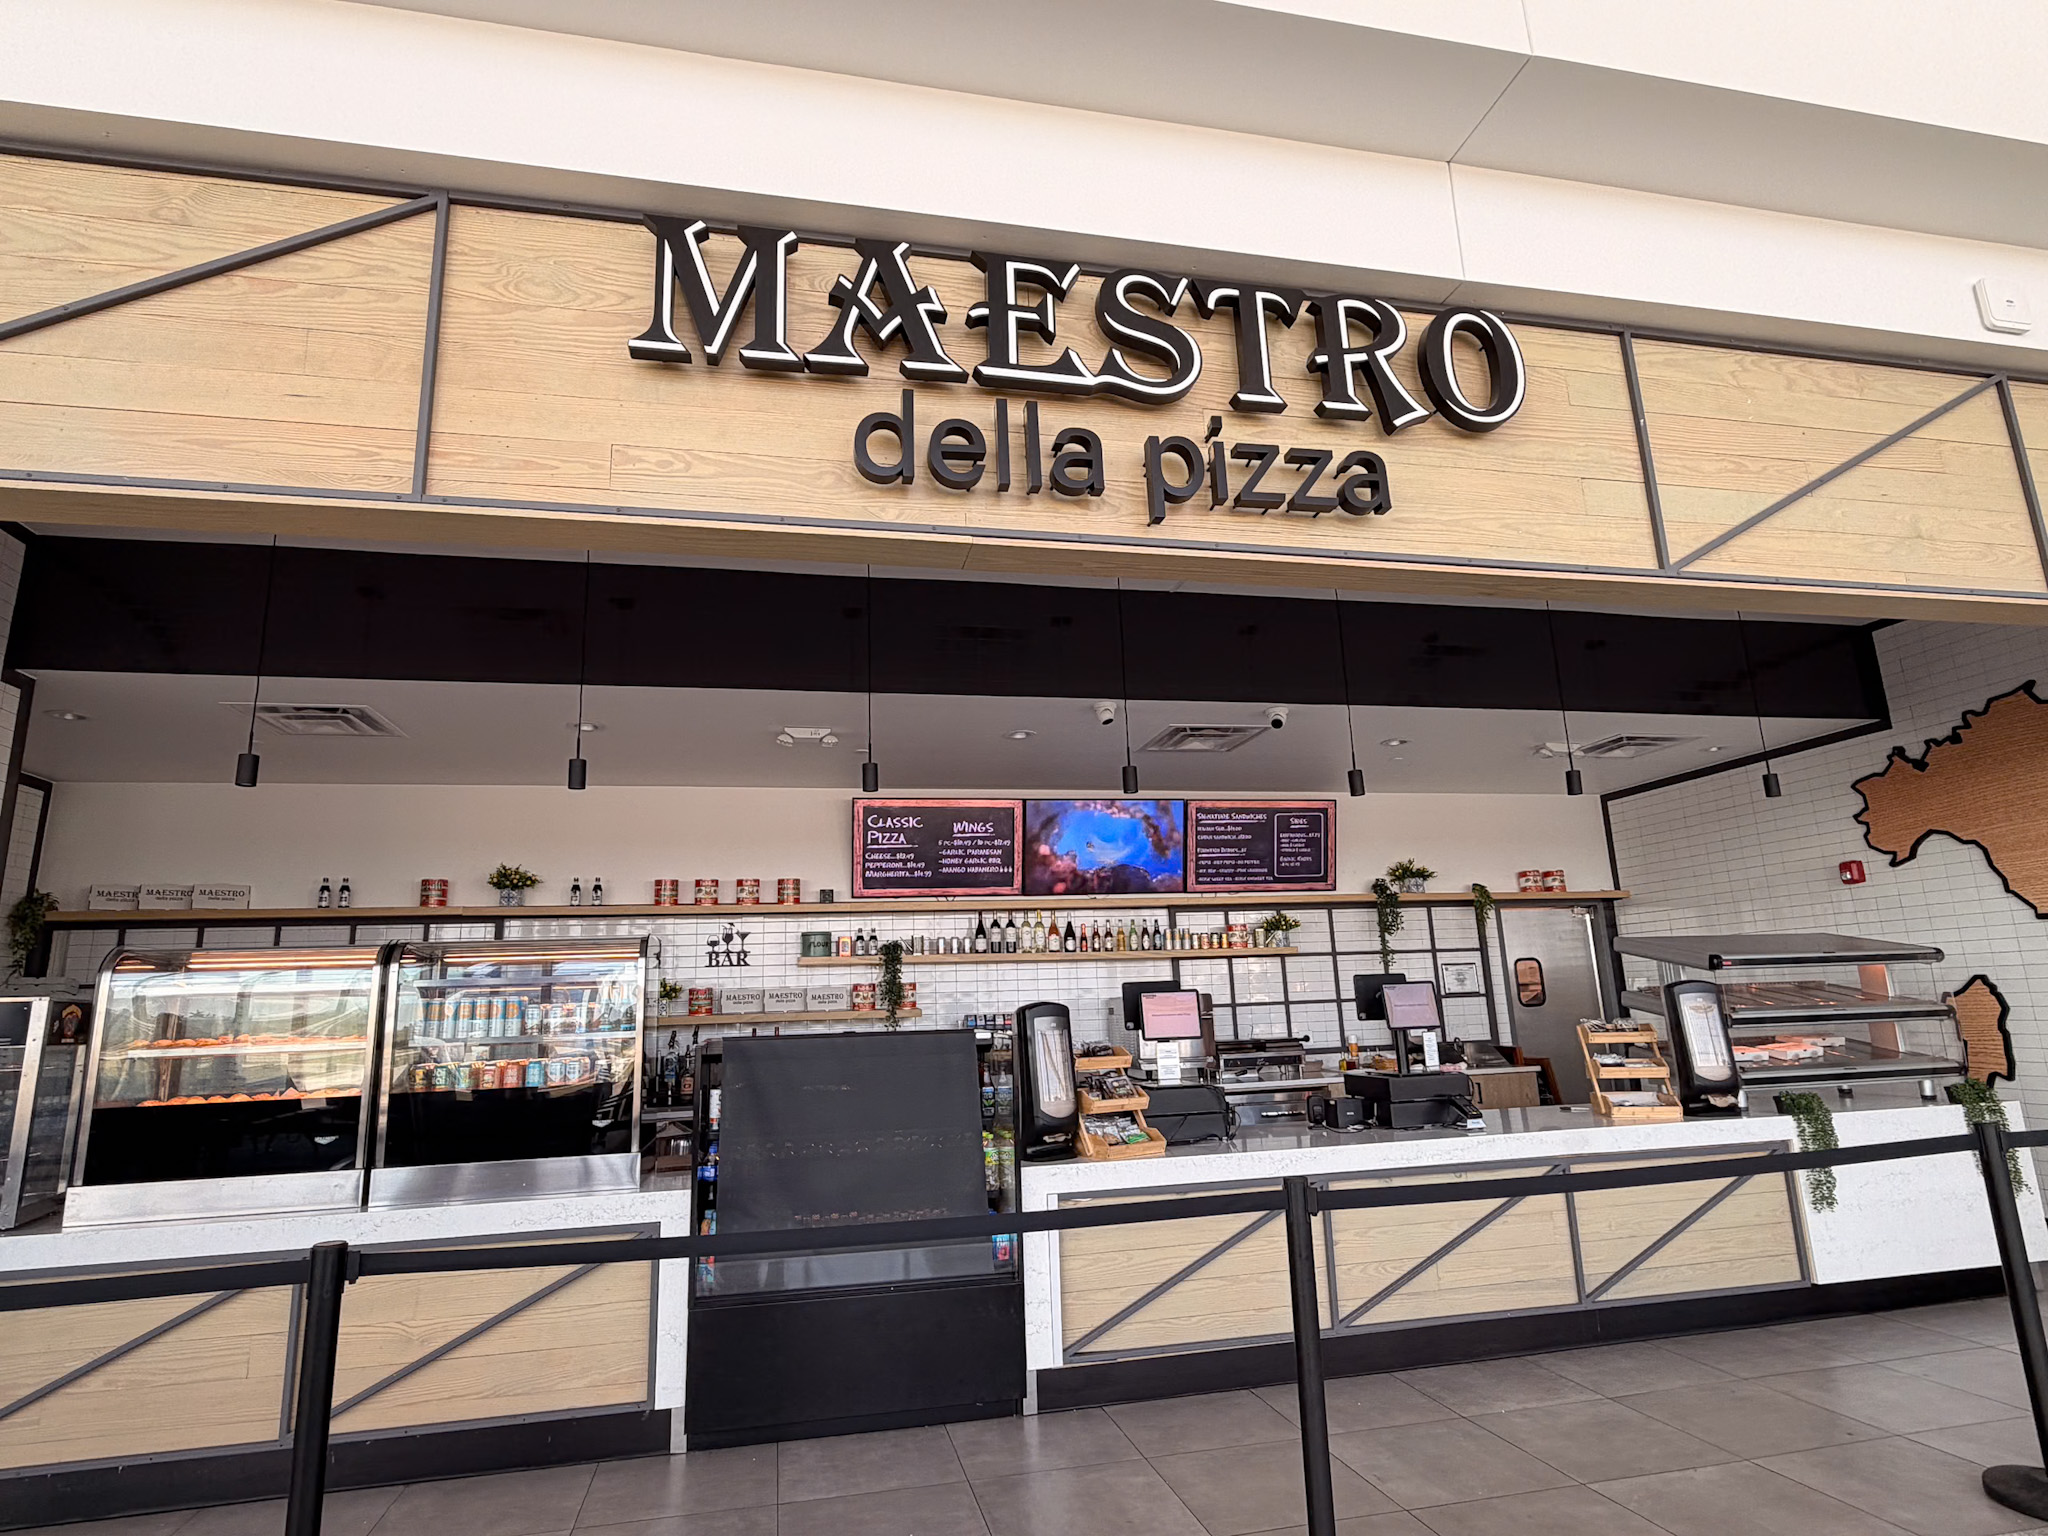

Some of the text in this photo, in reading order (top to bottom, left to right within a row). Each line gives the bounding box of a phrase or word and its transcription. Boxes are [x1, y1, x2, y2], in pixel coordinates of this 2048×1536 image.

[628, 213, 1527, 436] MAESTRO
[853, 388, 1393, 526] della pizza
[867, 814, 924, 829] CLASSIC
[952, 820, 995, 833] WINGS
[866, 830, 907, 845] PIZZA
[96, 890, 139, 898] MAESTR
[198, 889, 245, 897] MAESTRO
[705, 951, 751, 967] BAR
[726, 993, 761, 1001] MAESTRO
[768, 991, 803, 999] MAESTRO
